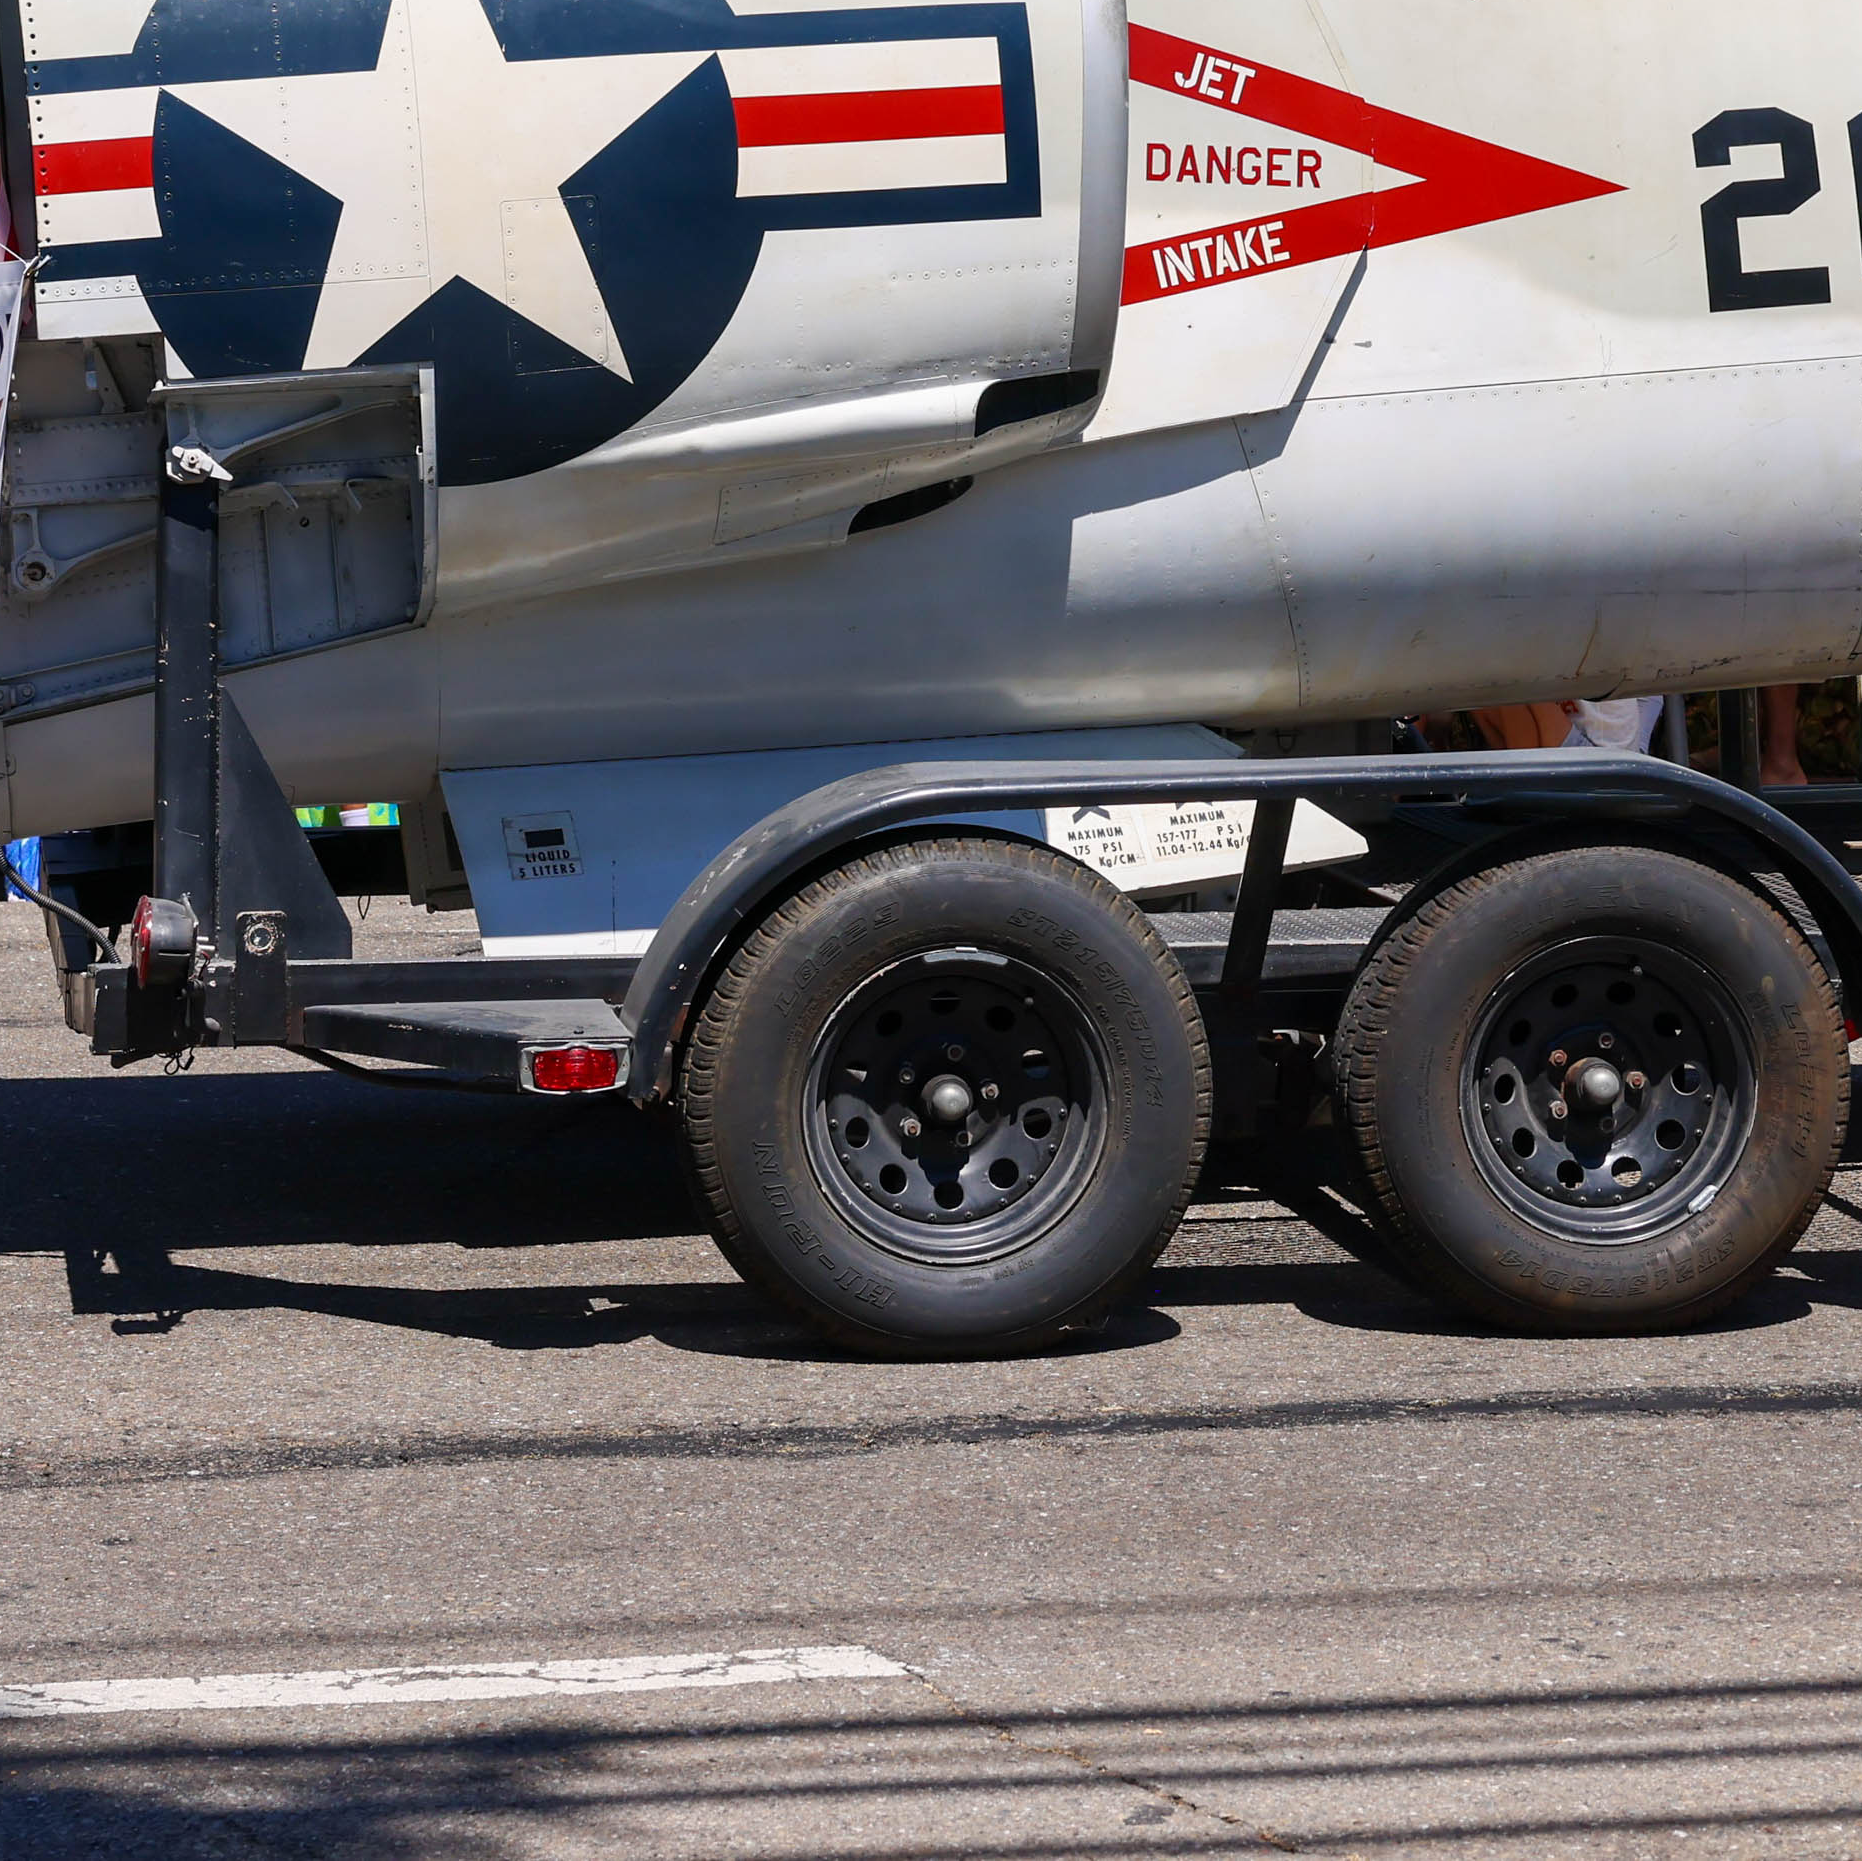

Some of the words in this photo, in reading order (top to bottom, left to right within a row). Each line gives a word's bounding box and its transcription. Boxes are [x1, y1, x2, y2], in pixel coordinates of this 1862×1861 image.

[1174, 52, 1256, 105] JET
[1146, 143, 1321, 188] DANGER
[1152, 220, 1291, 289] INTAKE
[1169, 809, 1225, 827] MAXIMUM
[1067, 825, 1124, 842] MAXIMUM
[1157, 829, 1197, 844] 157-177
[525, 849, 571, 864] LIQUID
[1073, 845, 1091, 856] 175
[1102, 841, 1123, 853] PSI
[519, 867, 526, 879] 5
[532, 862, 577, 877] LITERS
[751, 1139, 899, 1310] HI-RUN
